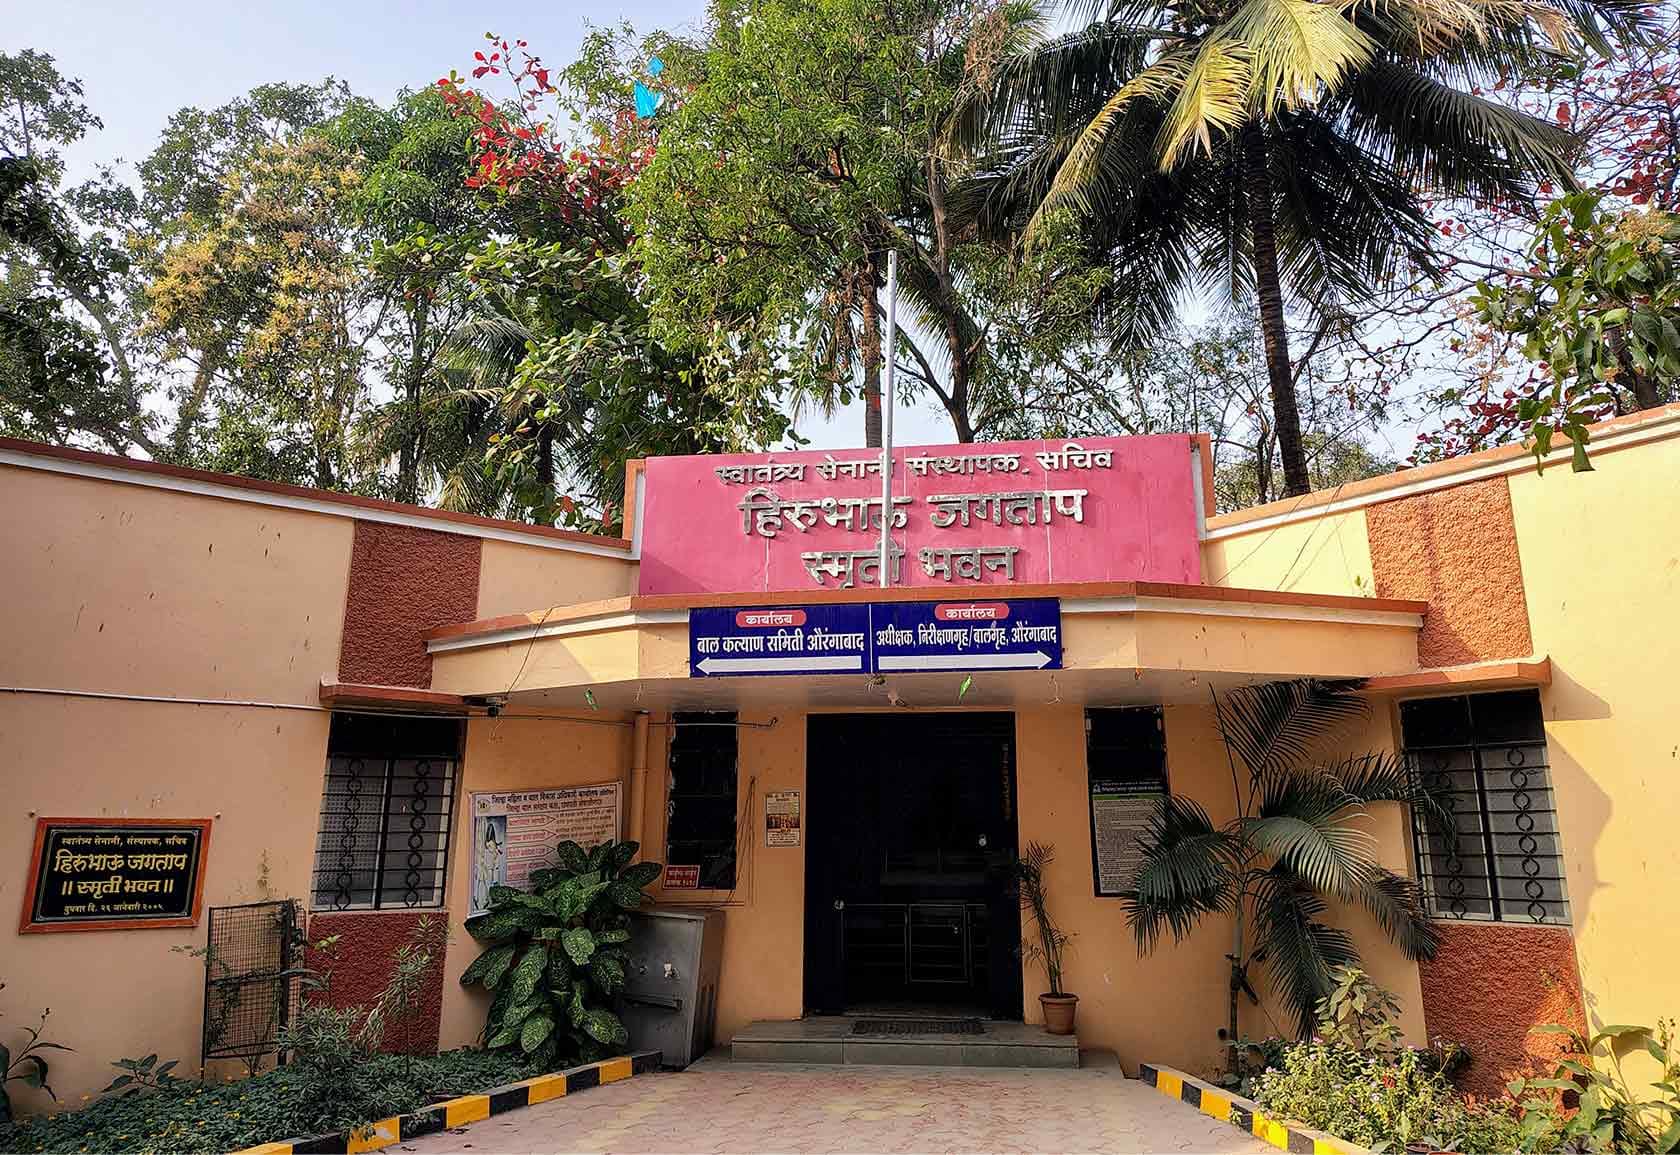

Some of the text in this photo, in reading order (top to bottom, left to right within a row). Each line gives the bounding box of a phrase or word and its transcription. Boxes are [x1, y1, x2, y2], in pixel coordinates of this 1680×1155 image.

[1036, 442, 1114, 470] सचिव
[927, 489, 1088, 528] जगताप
[919, 546, 1019, 581] भवन
[746, 611, 793, 625] कार्यालय
[945, 605, 996, 619] कार्यालय
[697, 628, 865, 654] बाल कल्याण समिती औरंगाबाद
[876, 624, 916, 647] अधीक्षक,
[1011, 621, 1057, 644] औरंगाबाद
[53, 848, 188, 874] हिरुभाऊ जगताप
[76, 875, 122, 899] स्मृती
[124, 879, 162, 894] भवन
